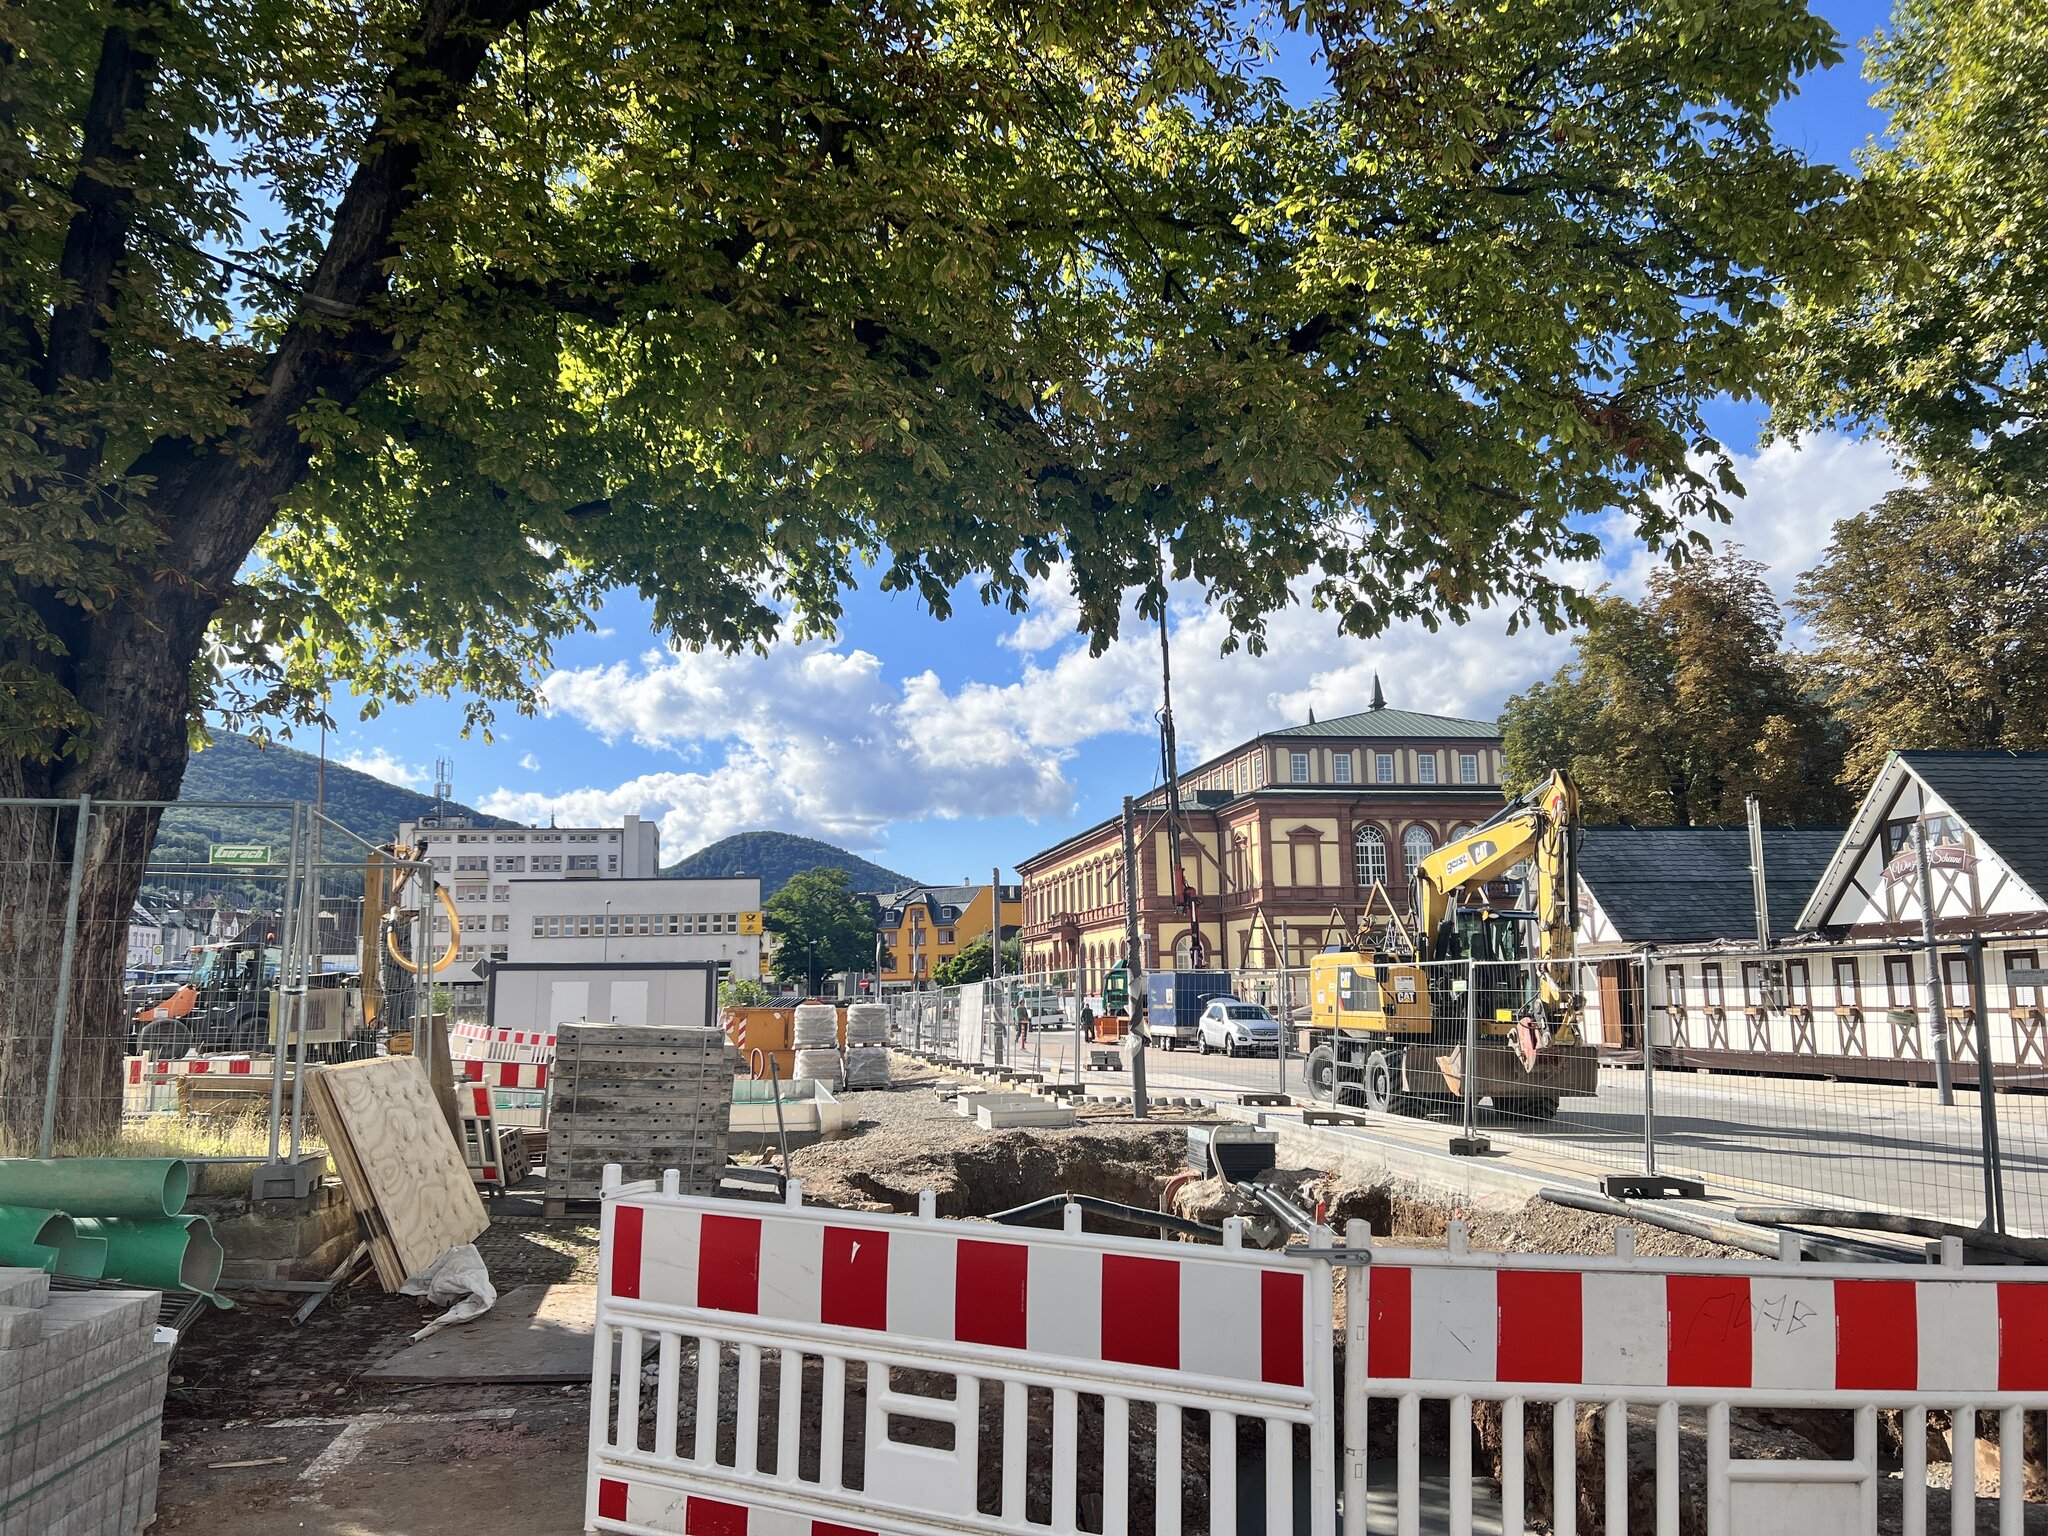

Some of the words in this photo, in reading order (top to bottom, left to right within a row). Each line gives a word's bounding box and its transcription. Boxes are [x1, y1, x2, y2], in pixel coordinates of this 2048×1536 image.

[214, 846, 266, 859] Gerach
[1932, 850, 1962, 864] Scheune
[1397, 992, 1415, 1003] CAT
